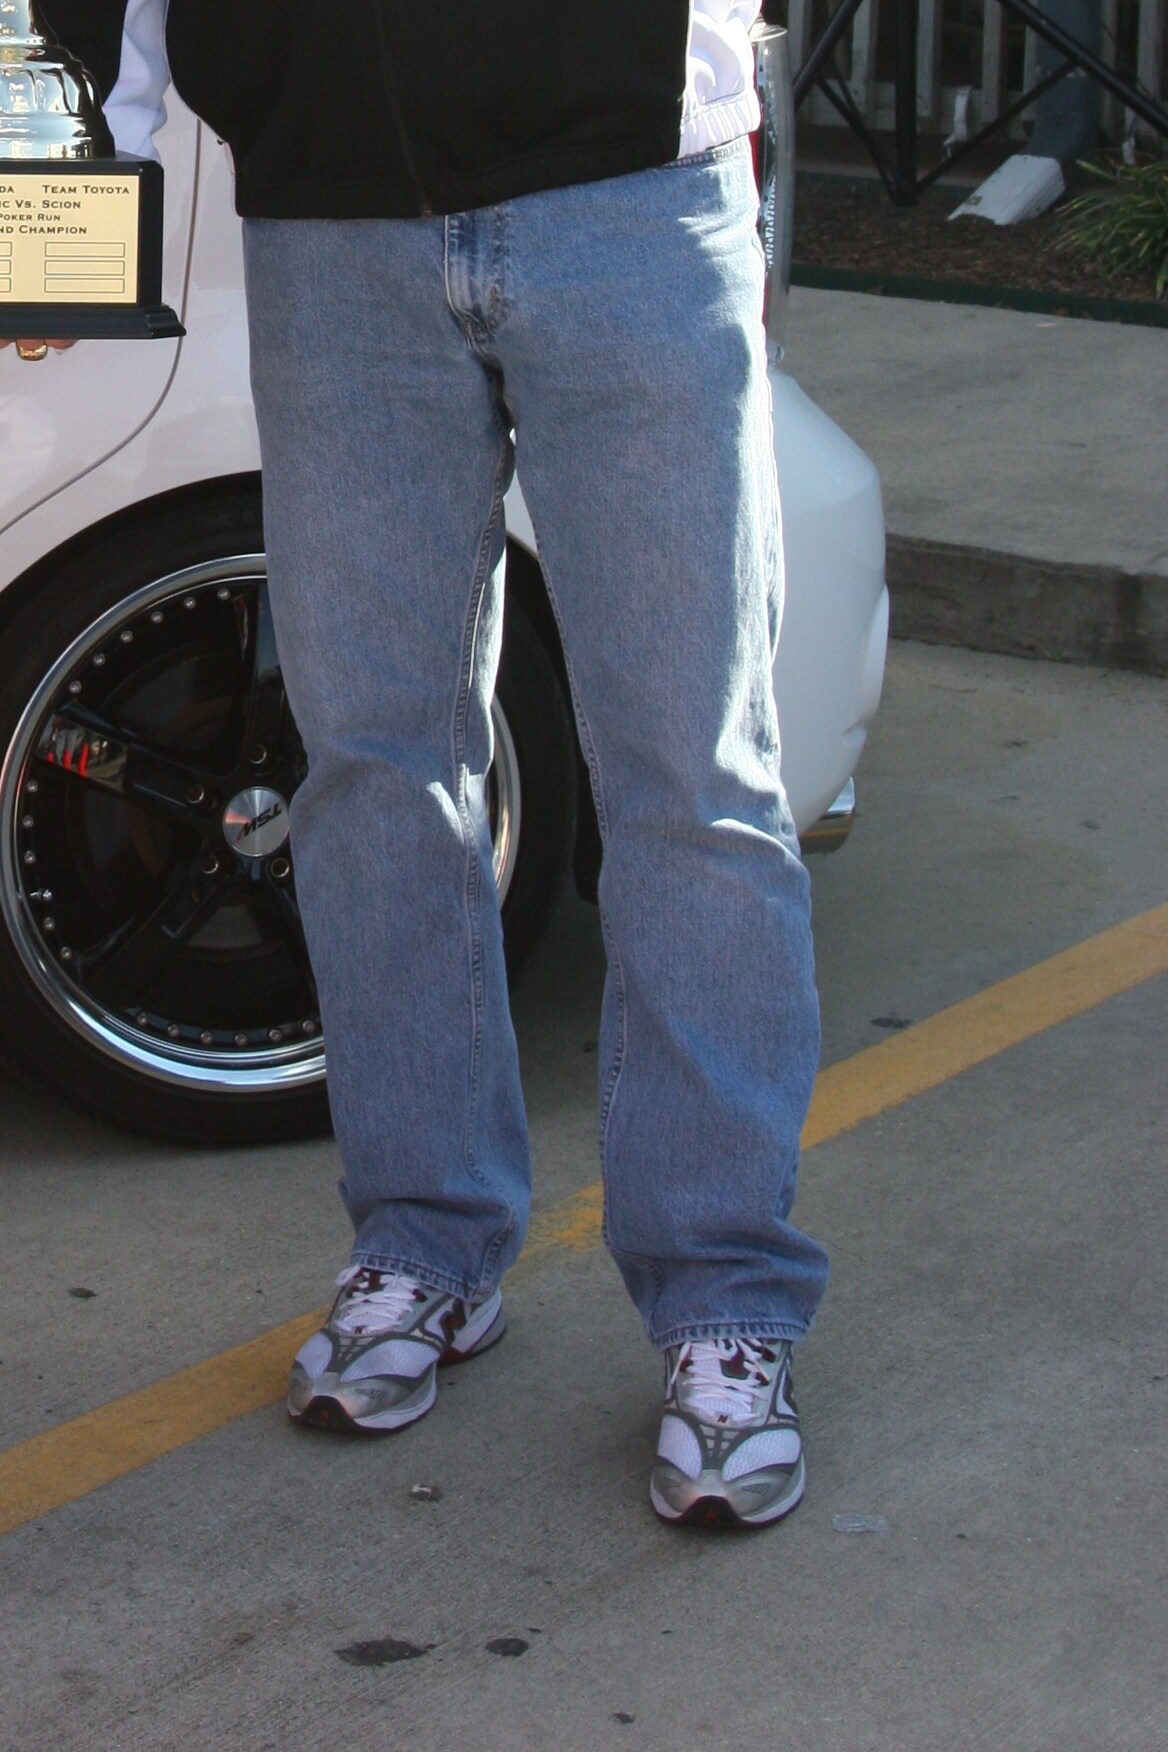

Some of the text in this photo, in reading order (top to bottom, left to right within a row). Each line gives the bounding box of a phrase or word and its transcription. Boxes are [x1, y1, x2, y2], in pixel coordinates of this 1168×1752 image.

[42, 184, 130, 195] TEAM TOYOTA
[14, 199, 36, 209] VS.
[41, 199, 81, 209] SCION
[37, 213, 61, 222] RUN
[18, 224, 87, 235] CHAMPION
